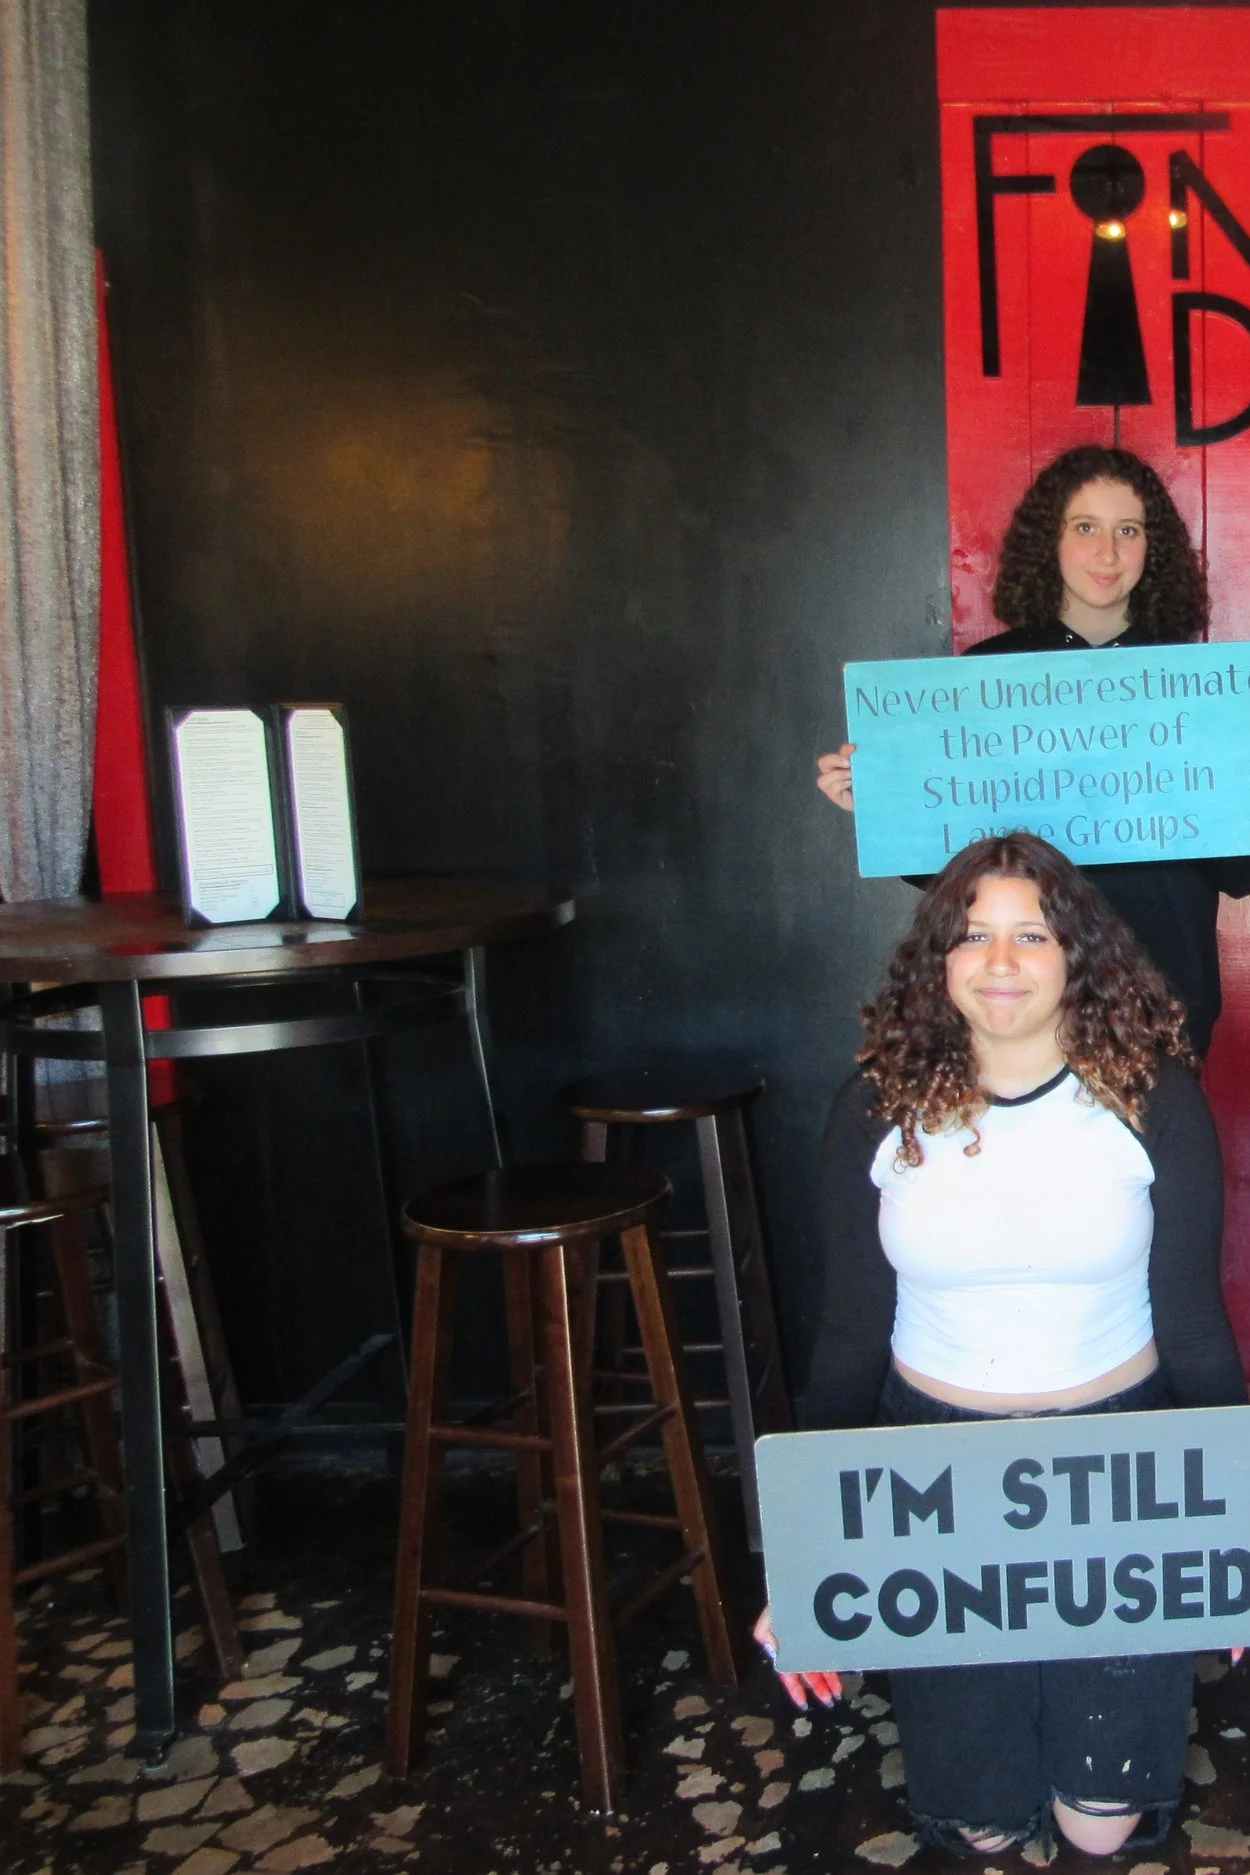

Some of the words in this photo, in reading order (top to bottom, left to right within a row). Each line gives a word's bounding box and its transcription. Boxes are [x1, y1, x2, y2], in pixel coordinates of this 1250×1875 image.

[856, 684, 970, 718] Never
[940, 727, 1004, 760] the
[1013, 720, 1139, 756] Power
[1149, 712, 1191, 747] of
[923, 768, 1046, 813] Stupid
[1054, 761, 1175, 805] People
[1183, 760, 1216, 792] in
[1066, 813, 1200, 850] Groups
[839, 1463, 955, 1540] I'M
[1002, 1448, 1227, 1530] STILL
